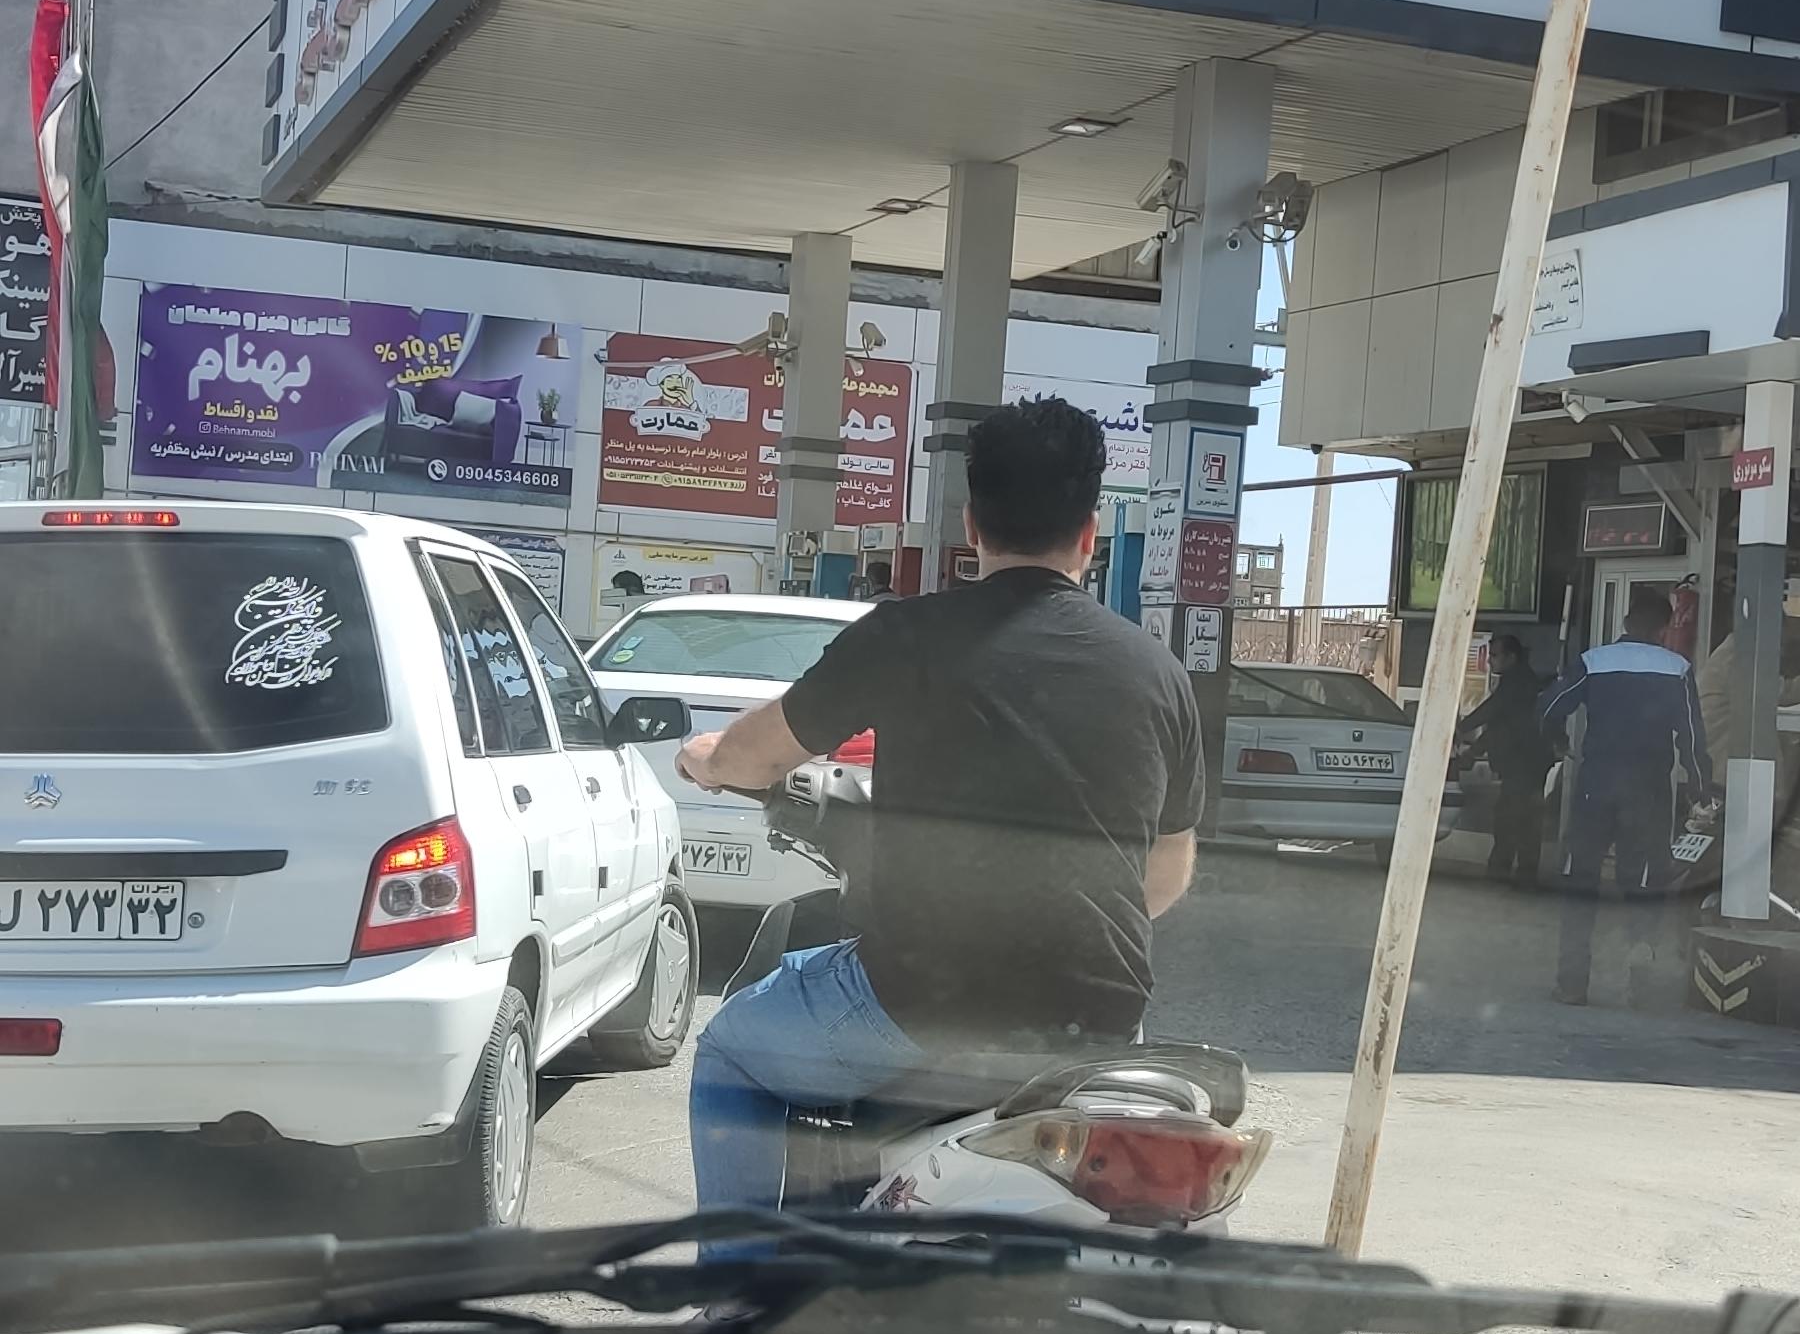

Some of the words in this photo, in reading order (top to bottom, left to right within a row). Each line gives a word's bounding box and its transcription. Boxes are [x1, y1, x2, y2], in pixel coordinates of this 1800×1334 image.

[243, 312, 256, 331] و
[400, 336, 425, 359] 10
[428, 343, 439, 360] و
[439, 332, 463, 353] 15
[188, 332, 311, 404] بهنام
[397, 359, 452, 387] تخفیف
[204, 400, 246, 418] اقساط
[246, 407, 255, 423] و
[256, 404, 279, 421] نقد
[150, 441, 190, 459] مظفریه
[191, 444, 217, 461] نبش
[225, 449, 260, 463] مدرس
[259, 450, 294, 466] ابتدای
[455, 465, 560, 487] 09045346608
[1757, 455, 1772, 480] سکو
[723, 851, 747, 872] ۳۲
[131, 884, 175, 894] ایران
[37, 888, 117, 933] ۲۷۳
[126, 896, 178, 935] ۳۲
